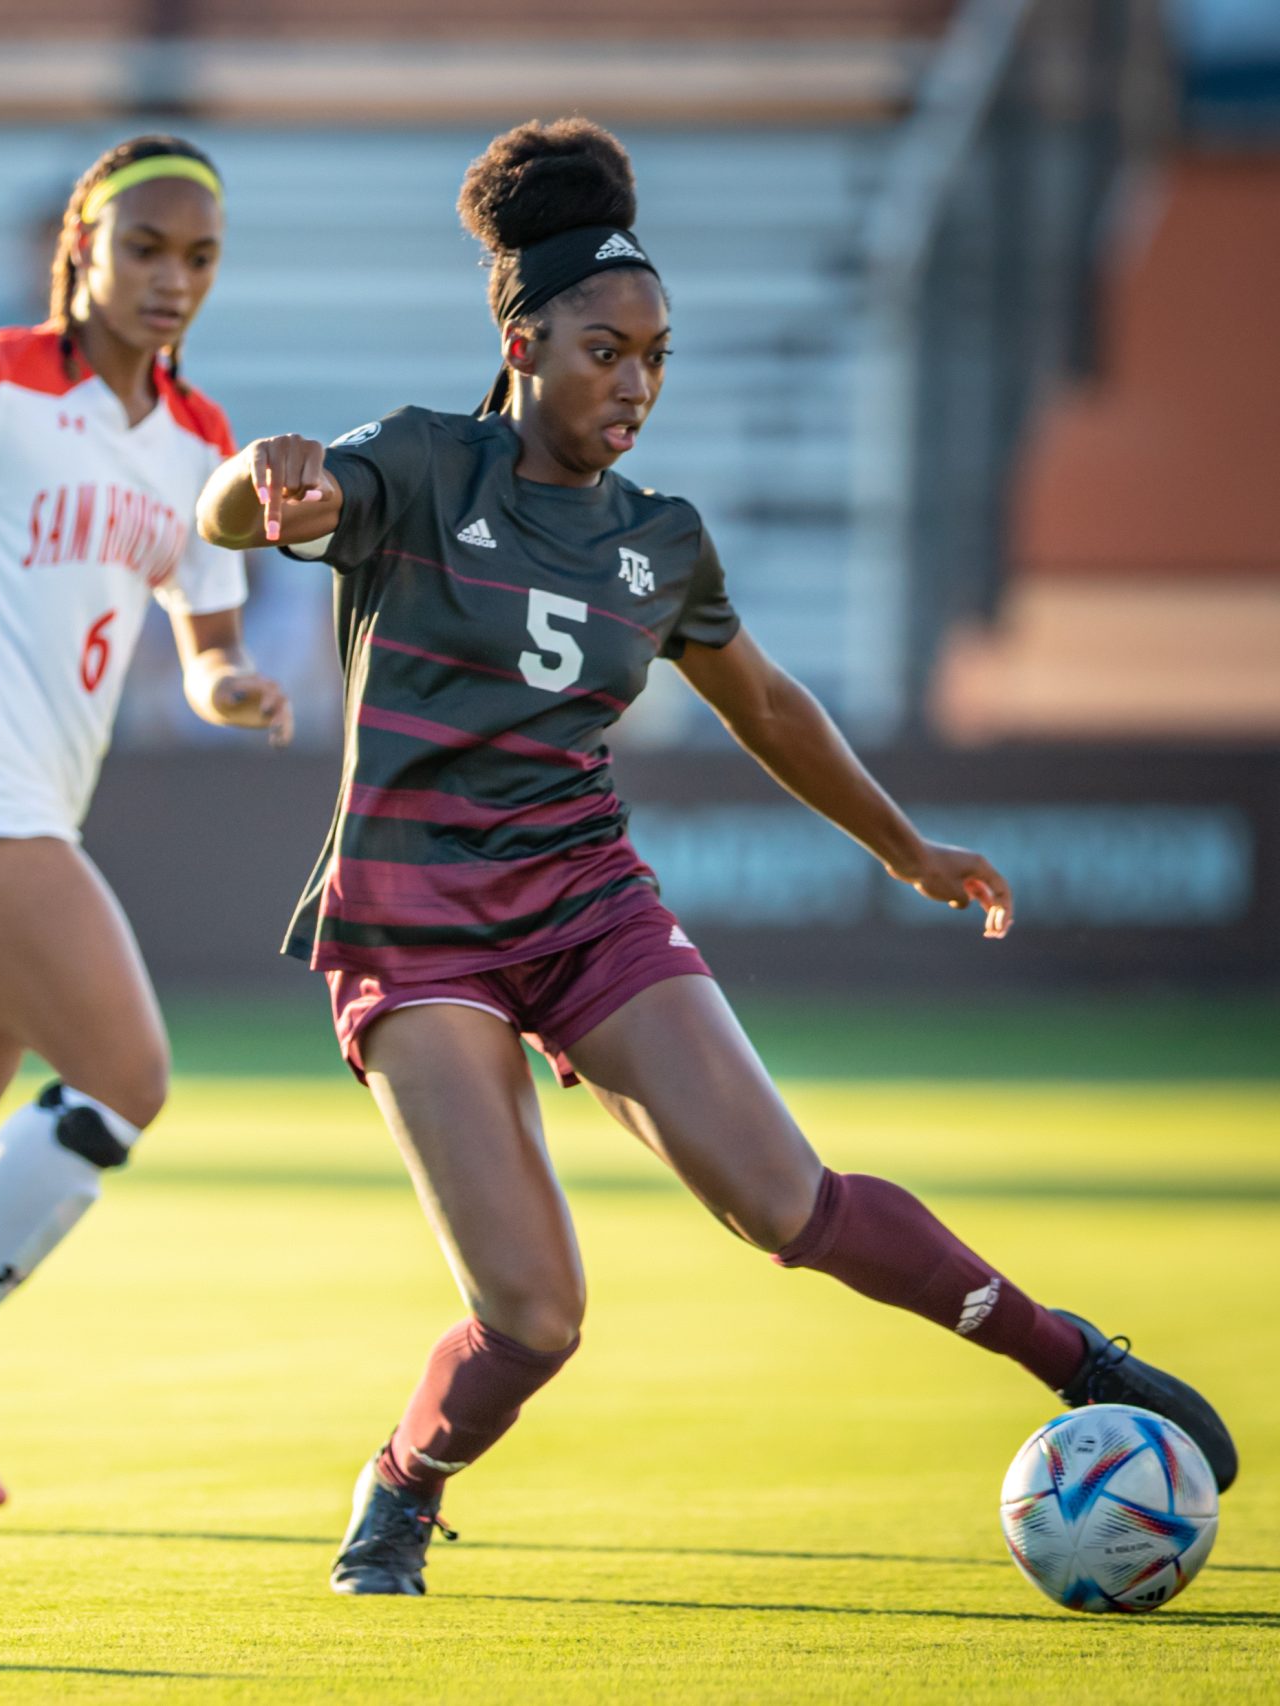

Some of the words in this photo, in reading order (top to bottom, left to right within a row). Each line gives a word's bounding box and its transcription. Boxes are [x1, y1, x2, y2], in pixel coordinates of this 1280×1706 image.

[594, 248, 646, 260] adidas
[21, 481, 96, 569] SAM
[99, 482, 188, 589] HOUSTO
[456, 532, 497, 549] adidas
[79, 608, 117, 694] 6
[517, 587, 588, 693] 5
